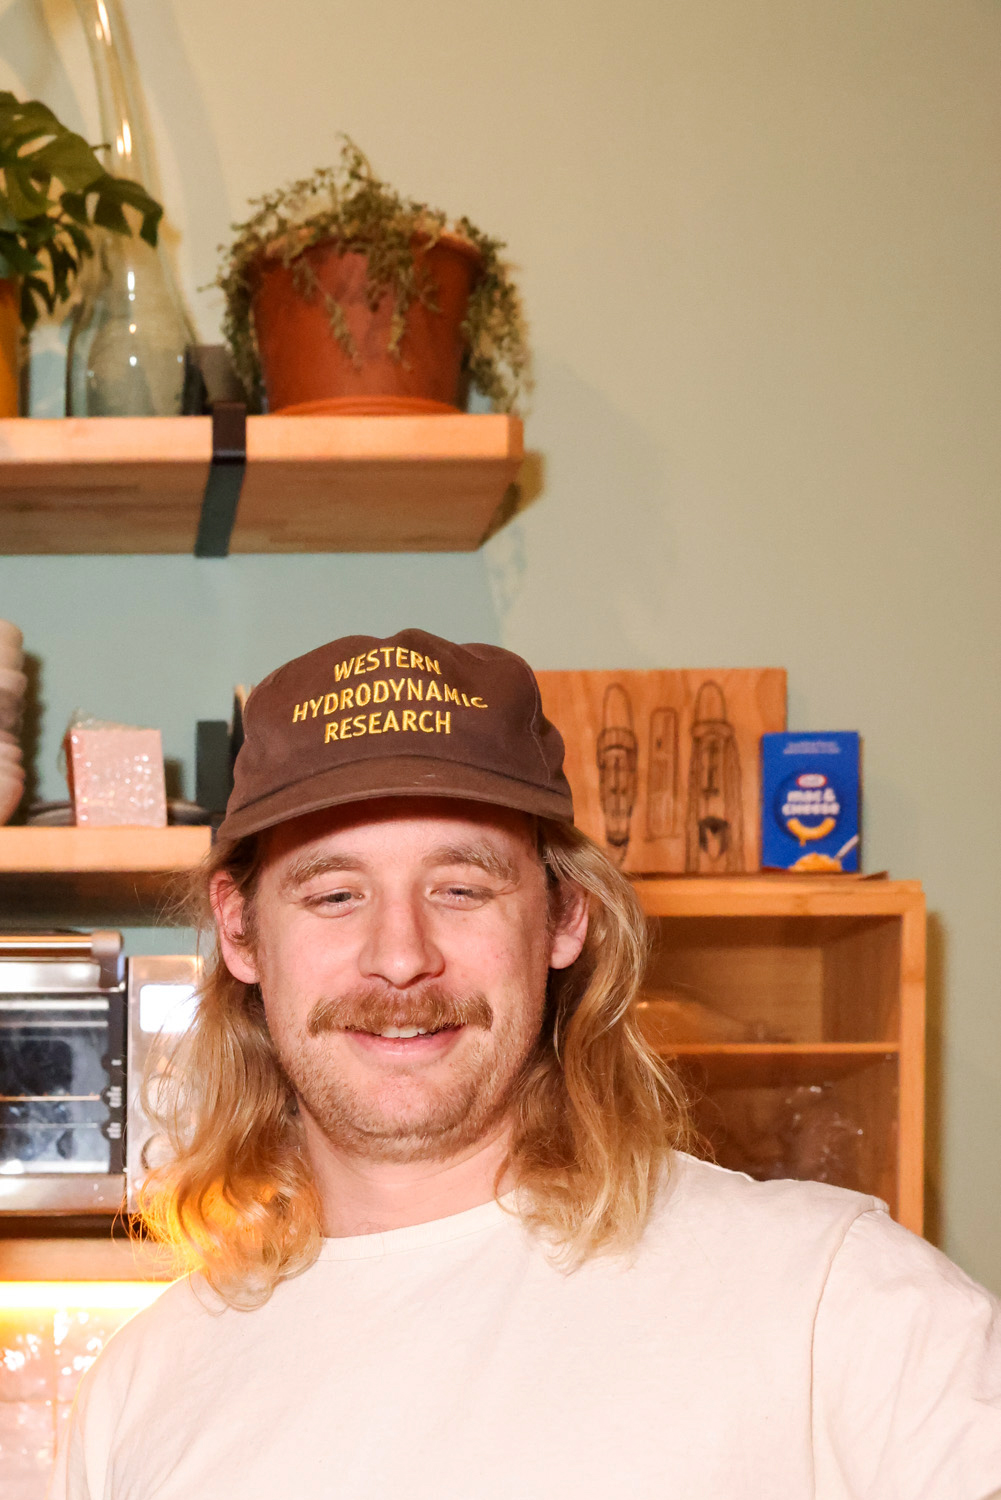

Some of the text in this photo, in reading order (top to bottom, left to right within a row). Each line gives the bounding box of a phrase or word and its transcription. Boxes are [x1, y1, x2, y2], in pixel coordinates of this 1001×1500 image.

[333, 646, 442, 682] WESTERN
[292, 677, 489, 723] HYDRODYNAMIC
[324, 709, 452, 744] RESEARCH
